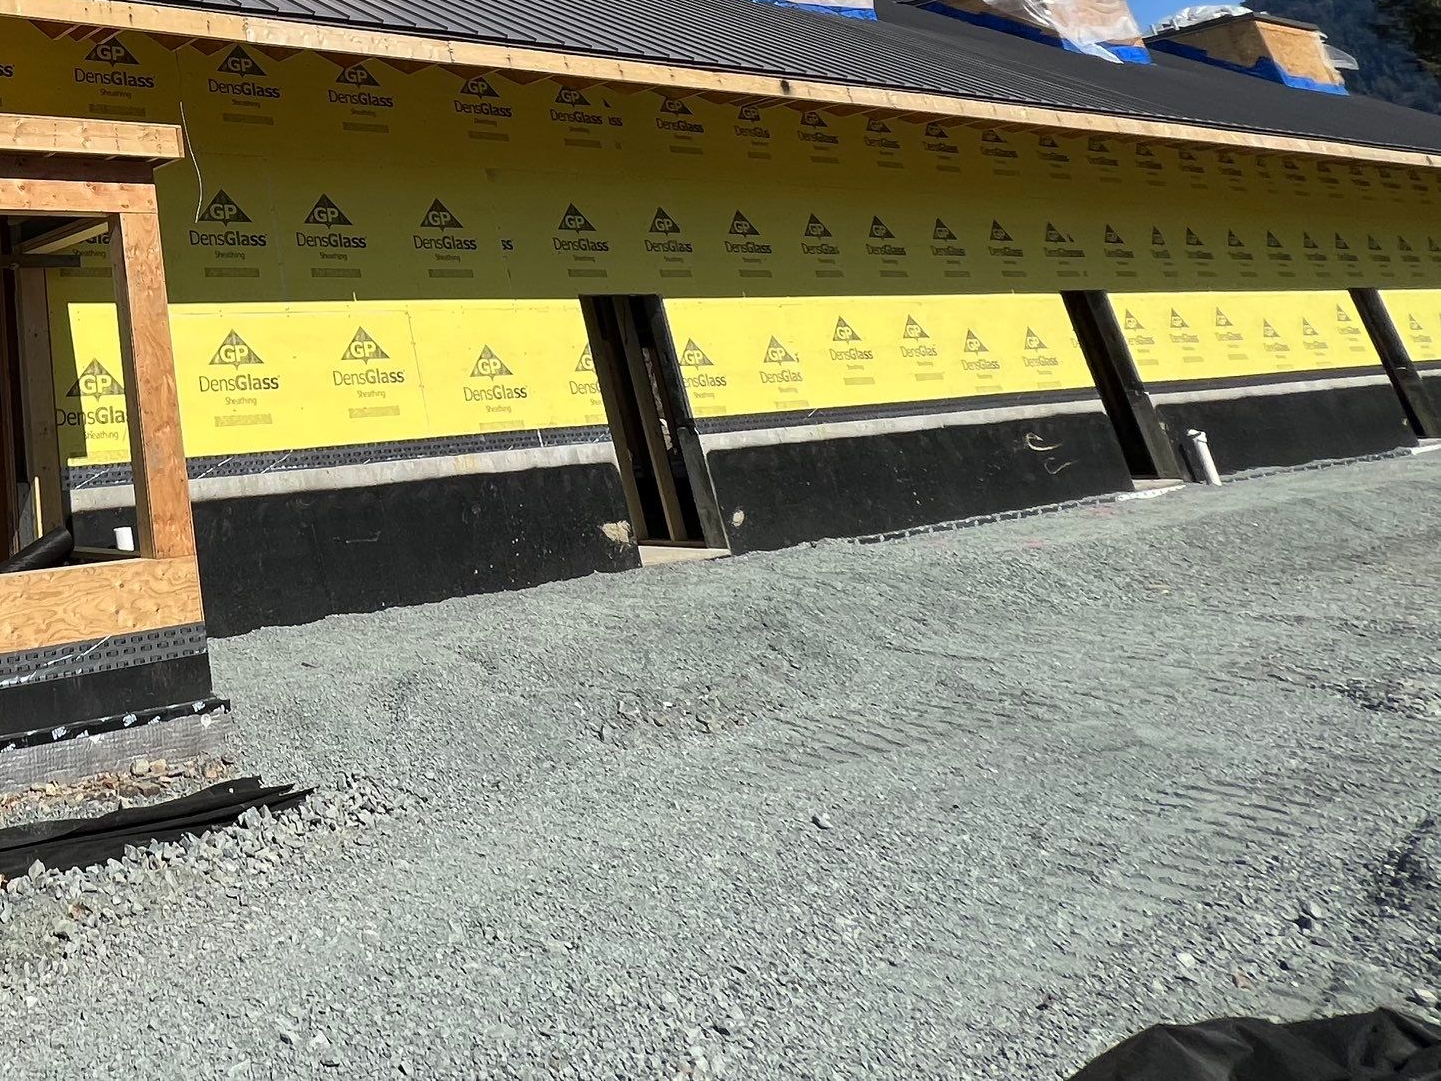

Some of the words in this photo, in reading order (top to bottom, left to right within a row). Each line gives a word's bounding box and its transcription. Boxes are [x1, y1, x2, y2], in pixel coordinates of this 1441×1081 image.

[96, 45, 125, 61] GP
[227, 58, 252, 73] GP
[74, 68, 154, 88] DensGlass
[344, 69, 367, 83] GP
[209, 79, 280, 98] DensGlass
[467, 81, 488, 94] GP
[327, 89, 393, 108] DensGlass
[561, 90, 580, 103] GP
[454, 100, 512, 118] DensGlass
[550, 109, 603, 125] DensGlass
[210, 204, 236, 219] GP
[314, 207, 338, 222] GP
[429, 211, 450, 226] GP
[565, 215, 584, 228] GP
[655, 218, 672, 230] GP
[734, 221, 750, 232] GP
[189, 230, 266, 246] DensGlass
[296, 232, 366, 248] DensGlass
[413, 235, 476, 250] DensGlass
[553, 237, 609, 251] DensGlass
[724, 241, 772, 253] DensGlass
[836, 326, 853, 340] GP
[219, 344, 249, 362] GP
[350, 341, 376, 357] GP
[768, 347, 786, 360] GP
[829, 348, 873, 361] DensGlass
[684, 350, 702, 365] GP
[478, 359, 501, 374] GP
[79, 375, 112, 394] GP
[199, 374, 279, 392] DensGlass
[333, 369, 404, 387] DensGlass
[683, 374, 727, 388] ensGlass
[463, 384, 527, 402] DensGlass
[225, 396, 257, 407] Sheathing
[55, 406, 125, 426] DensGla
